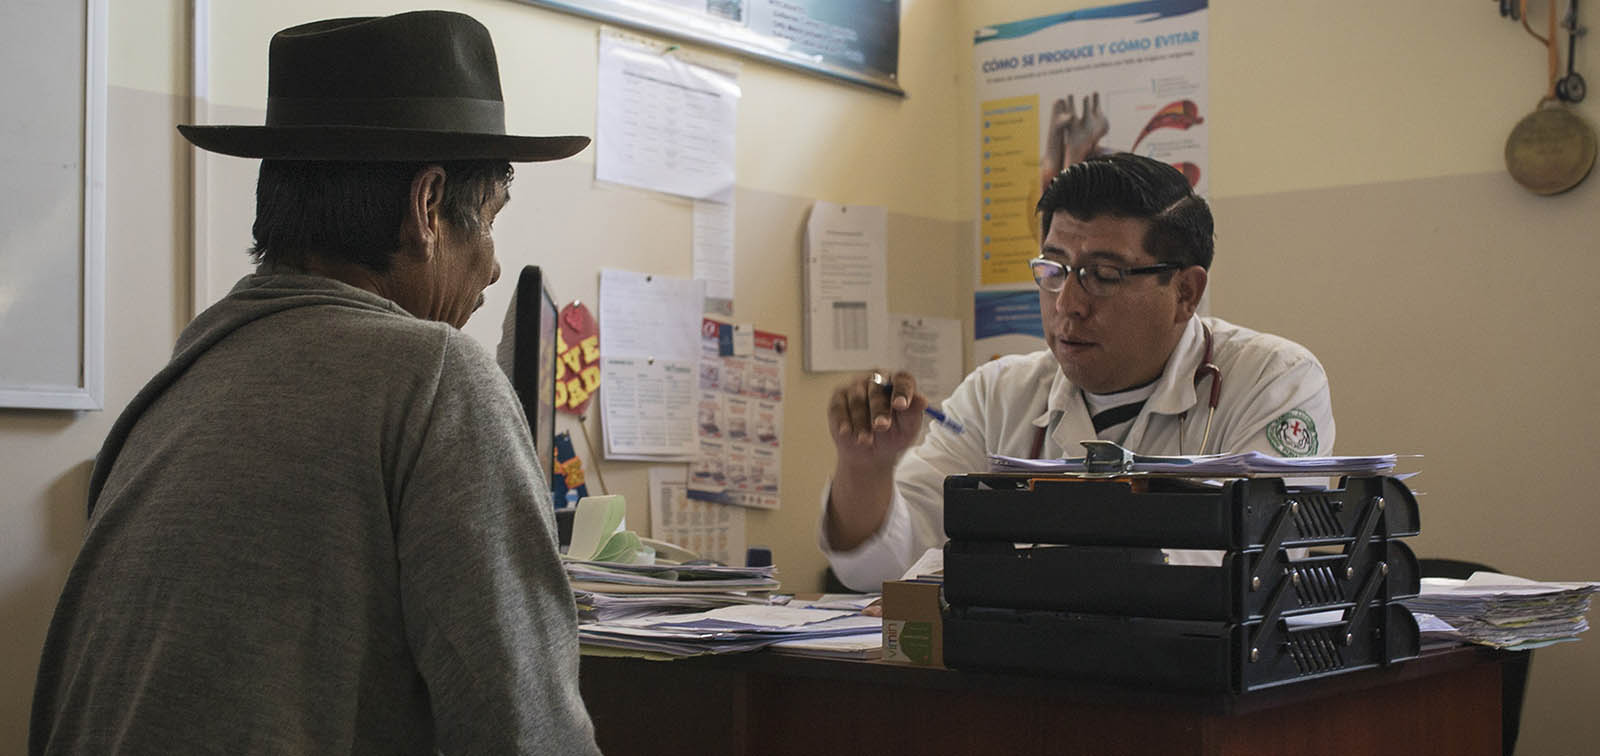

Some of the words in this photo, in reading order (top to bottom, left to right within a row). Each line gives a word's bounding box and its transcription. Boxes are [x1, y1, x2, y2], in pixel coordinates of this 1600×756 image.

[982, 54, 1019, 74] CÓMO
[1022, 52, 1036, 69] SE
[1038, 44, 1094, 65] PRODUCE
[1098, 43, 1105, 56] Y
[1109, 36, 1151, 55] CÓMO
[1155, 30, 1200, 49] EVITAR
